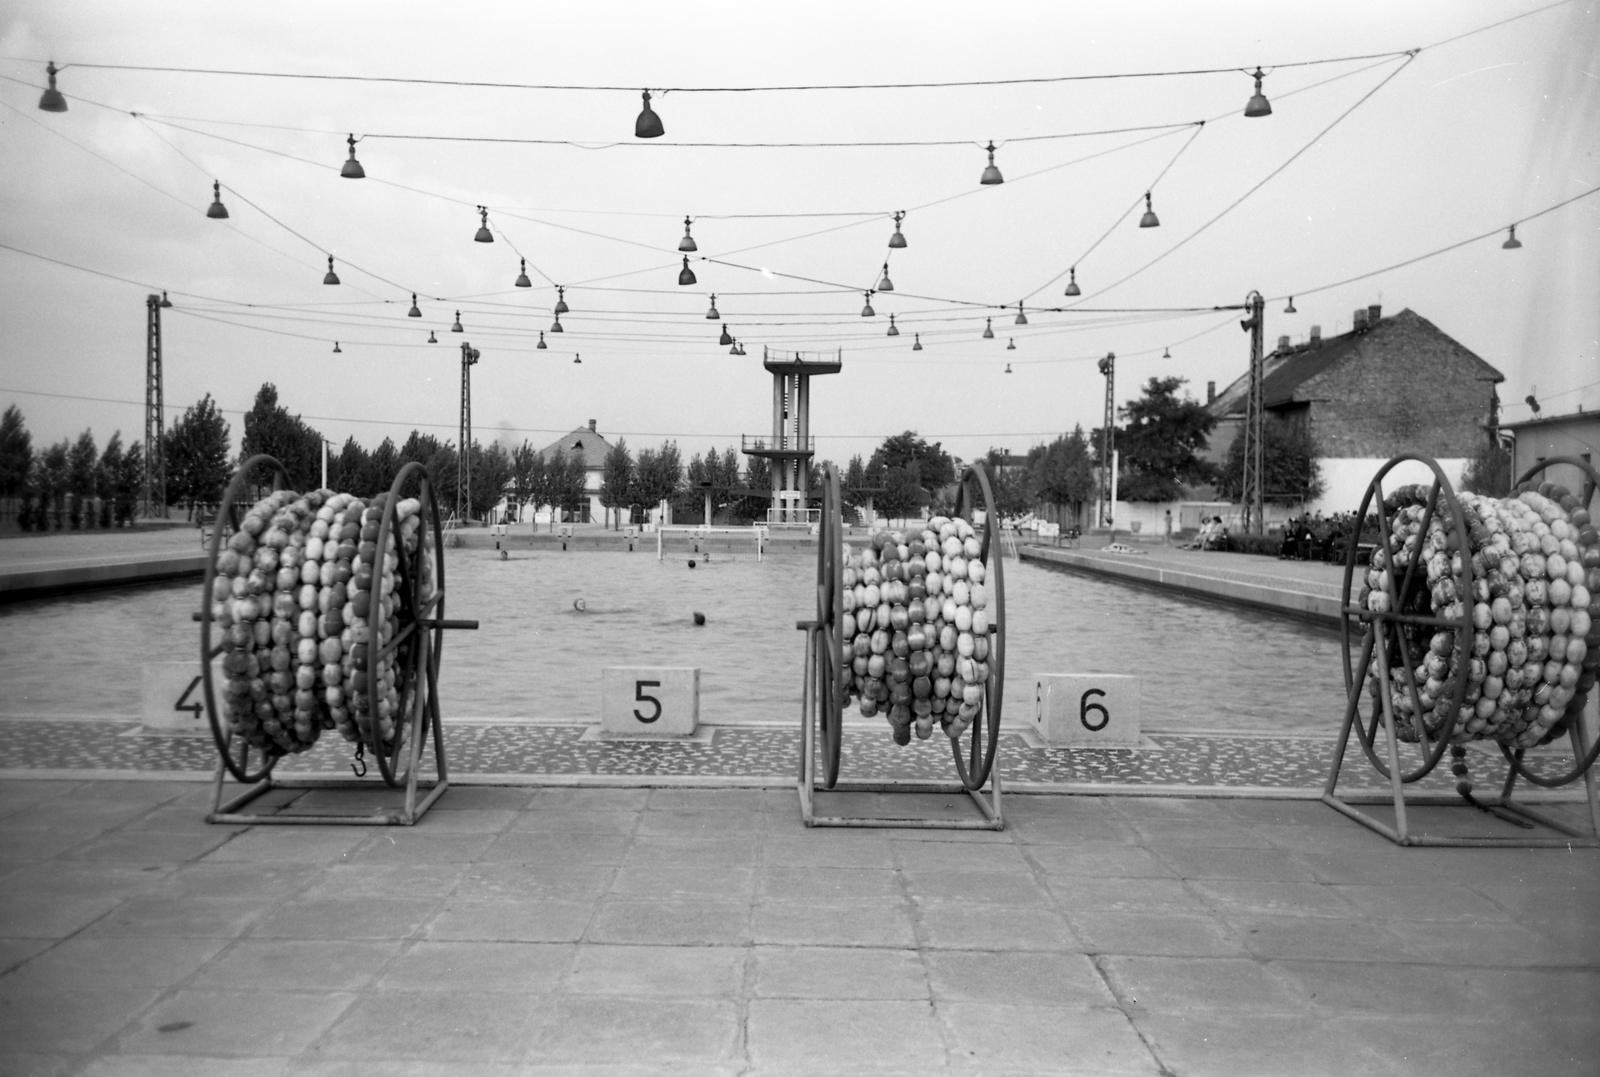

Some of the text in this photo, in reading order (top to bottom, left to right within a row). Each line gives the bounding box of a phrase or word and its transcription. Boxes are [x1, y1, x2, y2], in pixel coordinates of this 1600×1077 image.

[562, 527, 568, 536] 2
[628, 528, 634, 536] 3
[175, 676, 204, 719] 4
[633, 680, 662, 724] 5
[1081, 688, 1109, 732] 6
